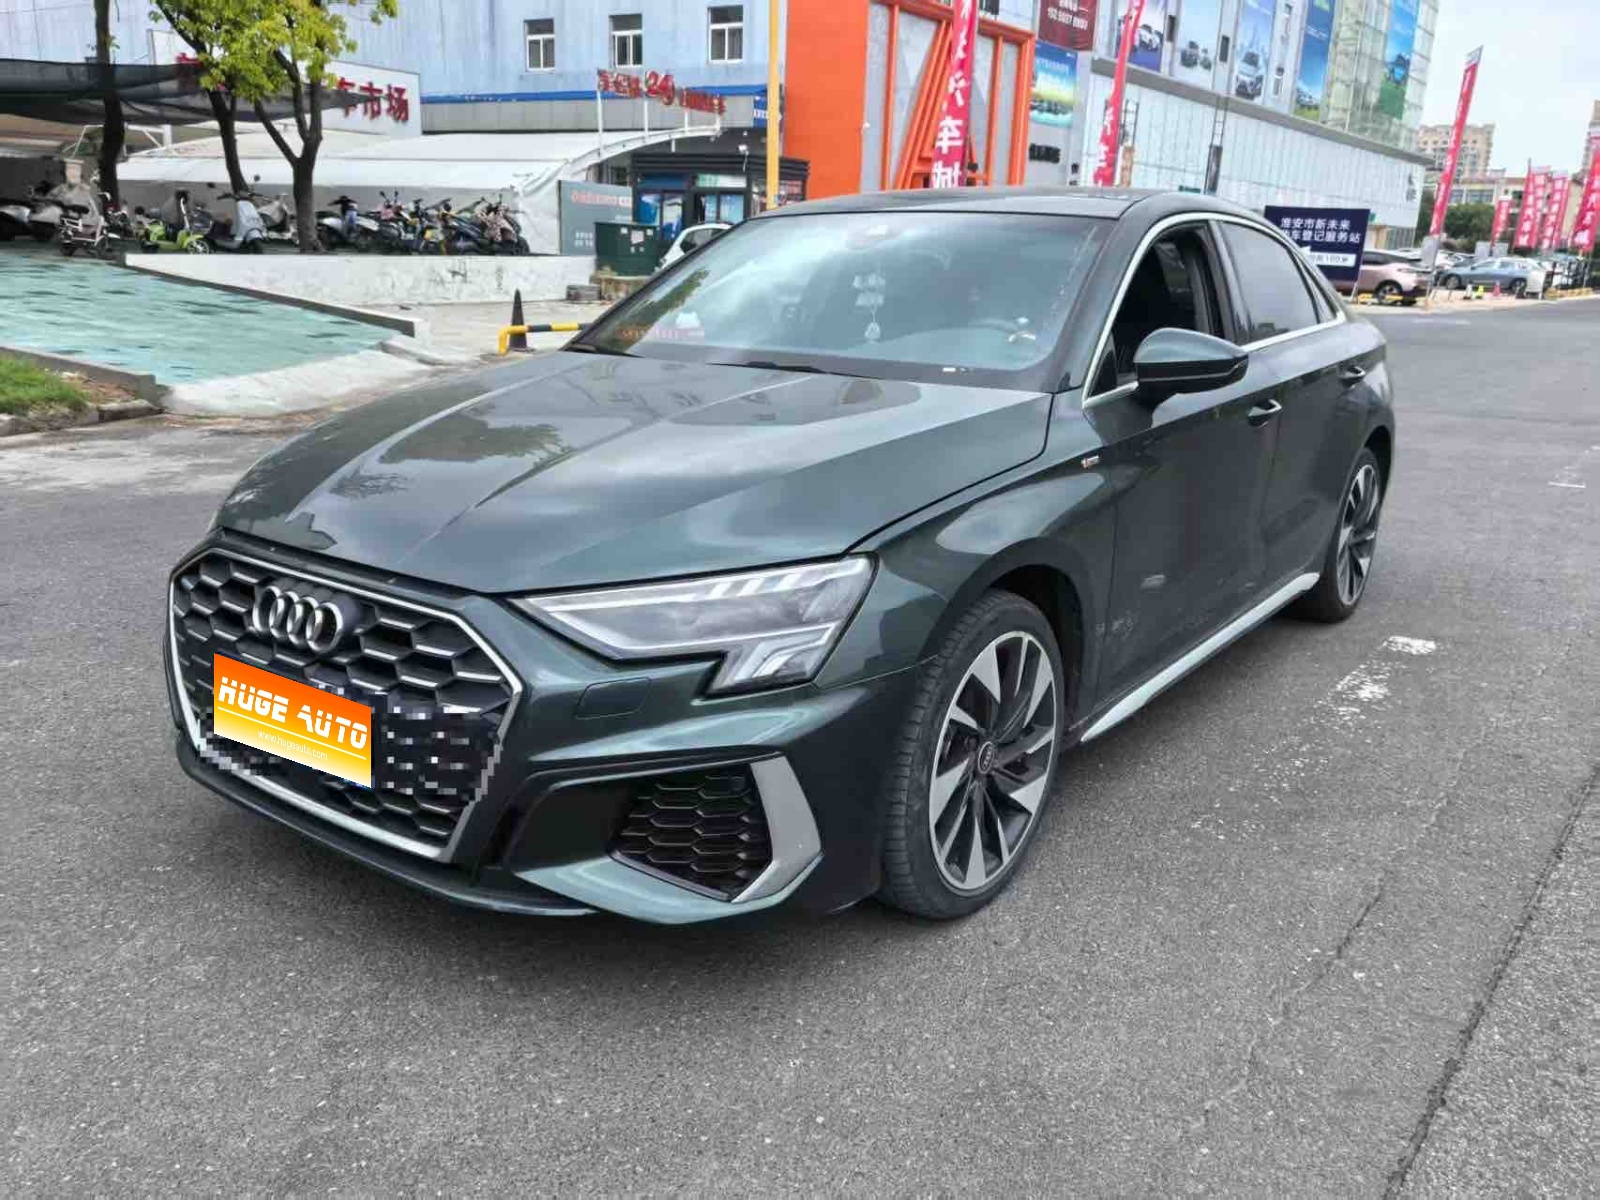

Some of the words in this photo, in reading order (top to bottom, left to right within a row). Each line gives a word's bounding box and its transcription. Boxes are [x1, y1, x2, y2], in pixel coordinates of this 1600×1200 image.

[1280, 217, 1351, 230] 淮安市新未来
